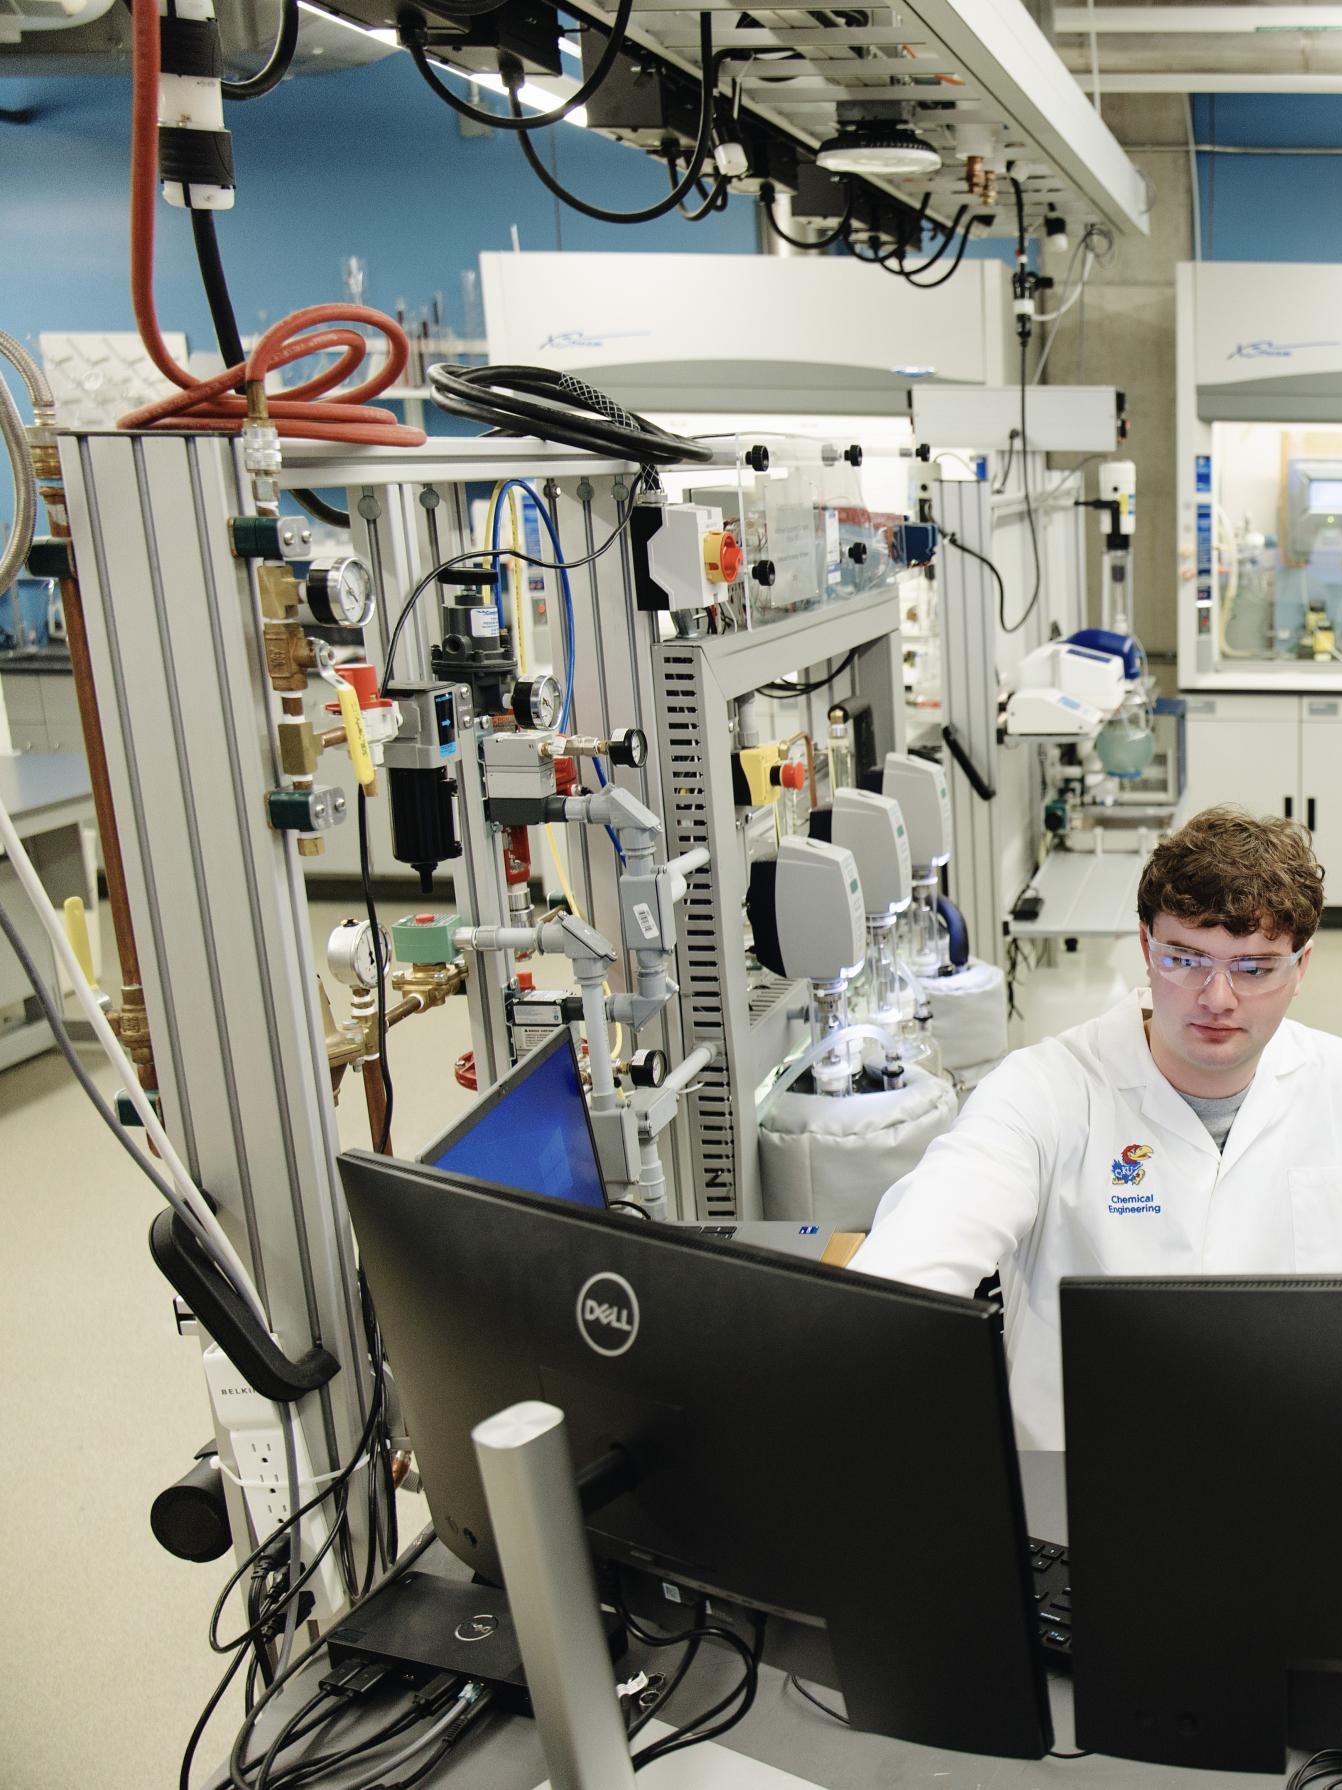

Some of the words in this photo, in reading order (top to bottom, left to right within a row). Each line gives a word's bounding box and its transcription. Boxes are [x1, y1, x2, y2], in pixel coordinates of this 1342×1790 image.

[1111, 1194, 1154, 1204] Chemical
[1108, 1204, 1161, 1215] Engineering
[584, 1299, 632, 1332] DELL
